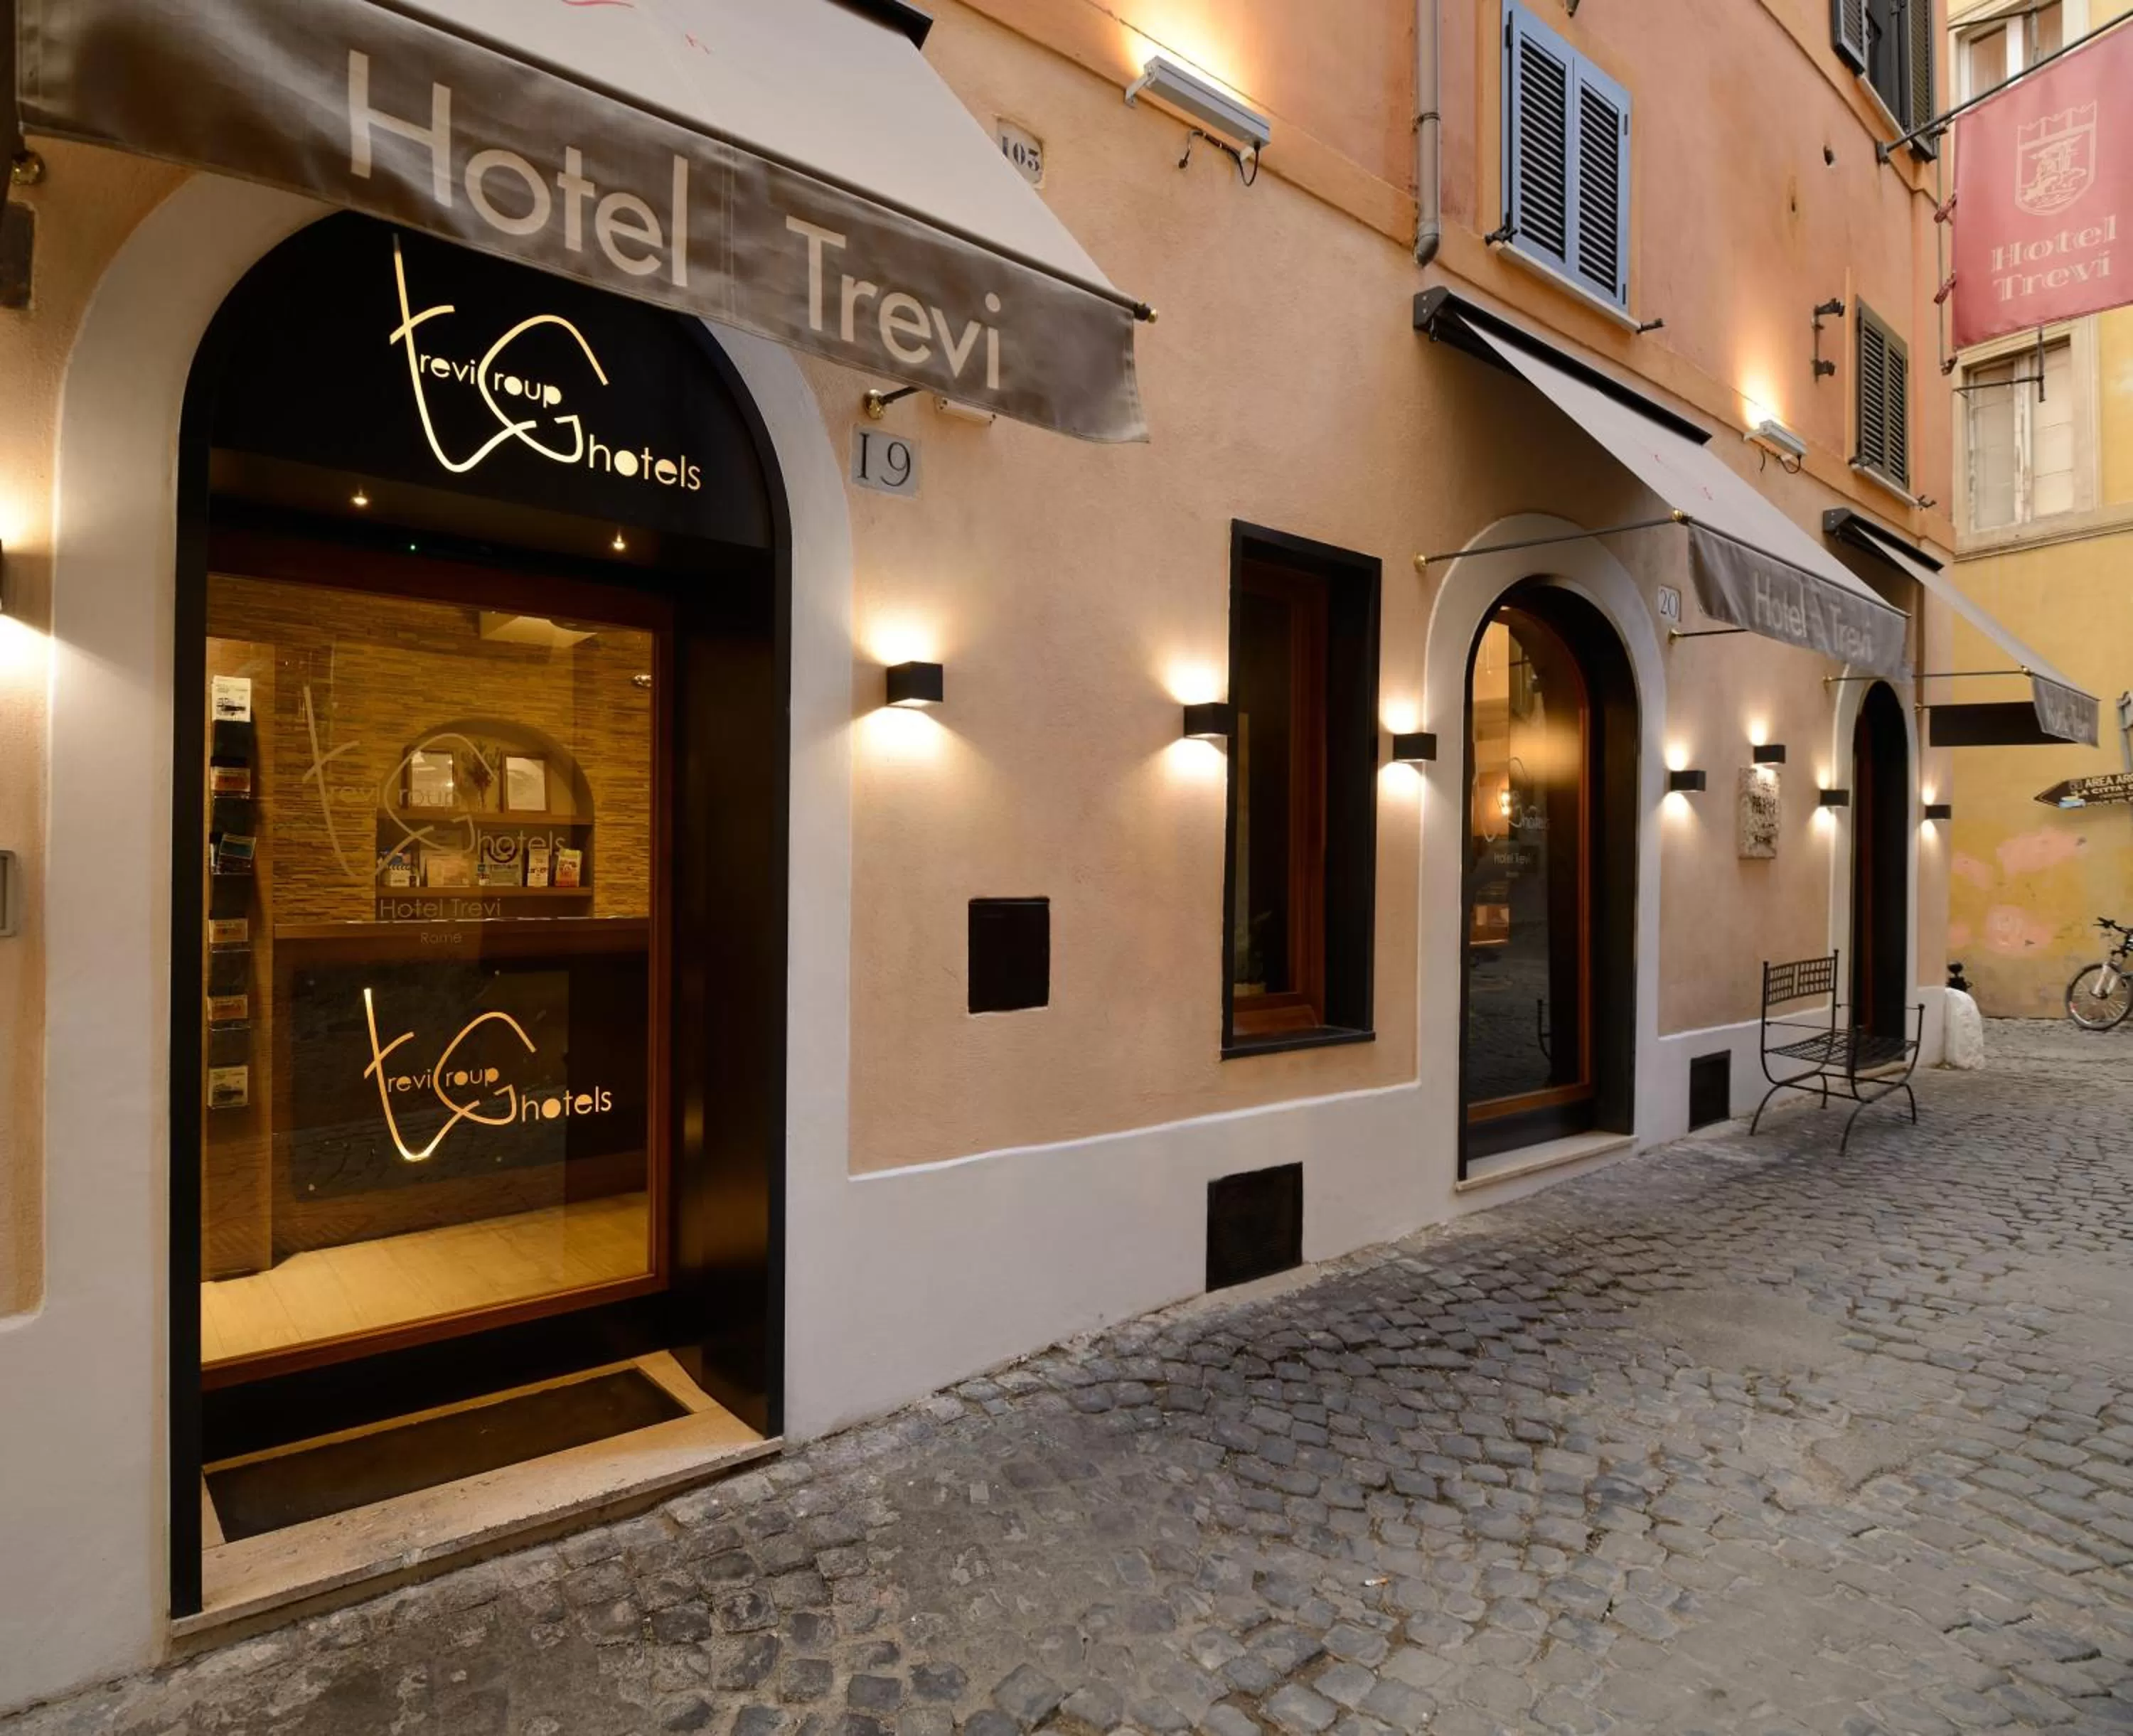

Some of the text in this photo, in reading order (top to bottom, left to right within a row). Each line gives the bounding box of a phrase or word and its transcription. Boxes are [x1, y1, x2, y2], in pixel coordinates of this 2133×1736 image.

[348, 49, 1001, 390] Hotel Trevi
[1992, 215, 2117, 272] Hotel
[1993, 250, 2111, 301] Trevi
[589, 433, 702, 491] hotels
[857, 432, 911, 486] 19
[1660, 589, 1678, 618] 20
[1755, 569, 1807, 638] Hotel
[2085, 776, 2114, 789] AREA
[477, 829, 567, 857] hotels
[380, 898, 501, 919] Hotel Trevi
[522, 1086, 612, 1122] hotels
